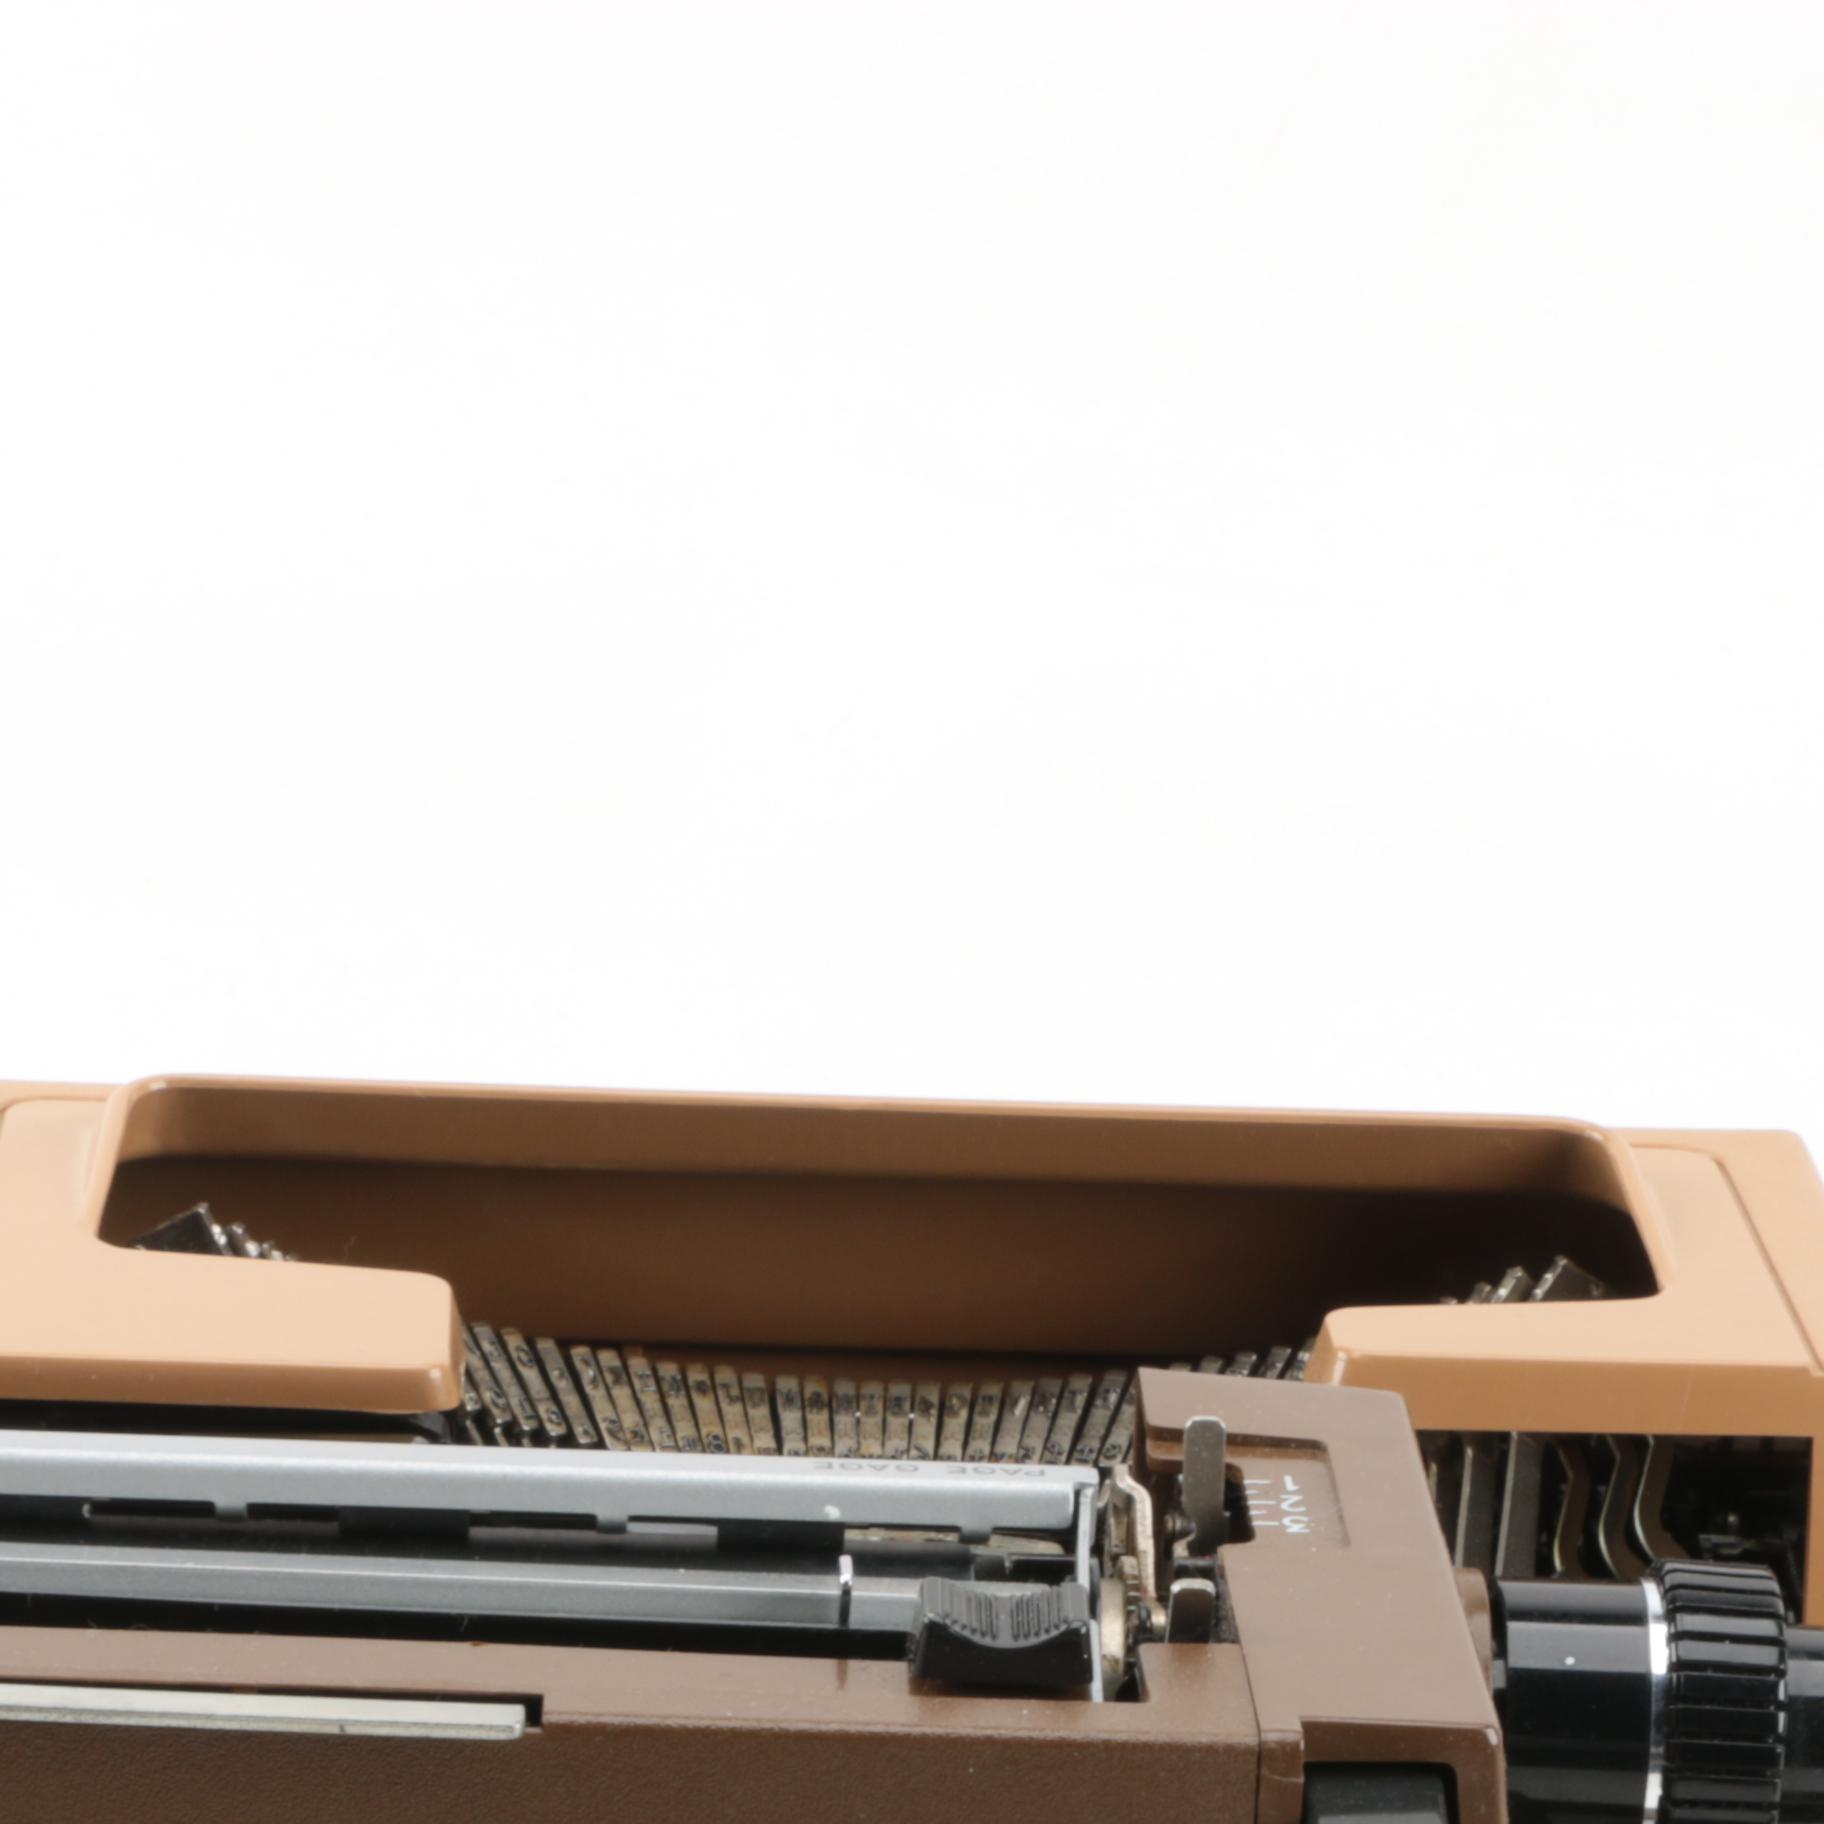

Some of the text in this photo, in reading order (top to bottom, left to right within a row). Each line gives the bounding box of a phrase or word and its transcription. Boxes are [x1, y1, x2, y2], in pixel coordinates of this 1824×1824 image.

[946, 1465, 1046, 1478] PAGE
[1279, 1494, 1307, 1513] 2
[1281, 1515, 1312, 1533] 3
